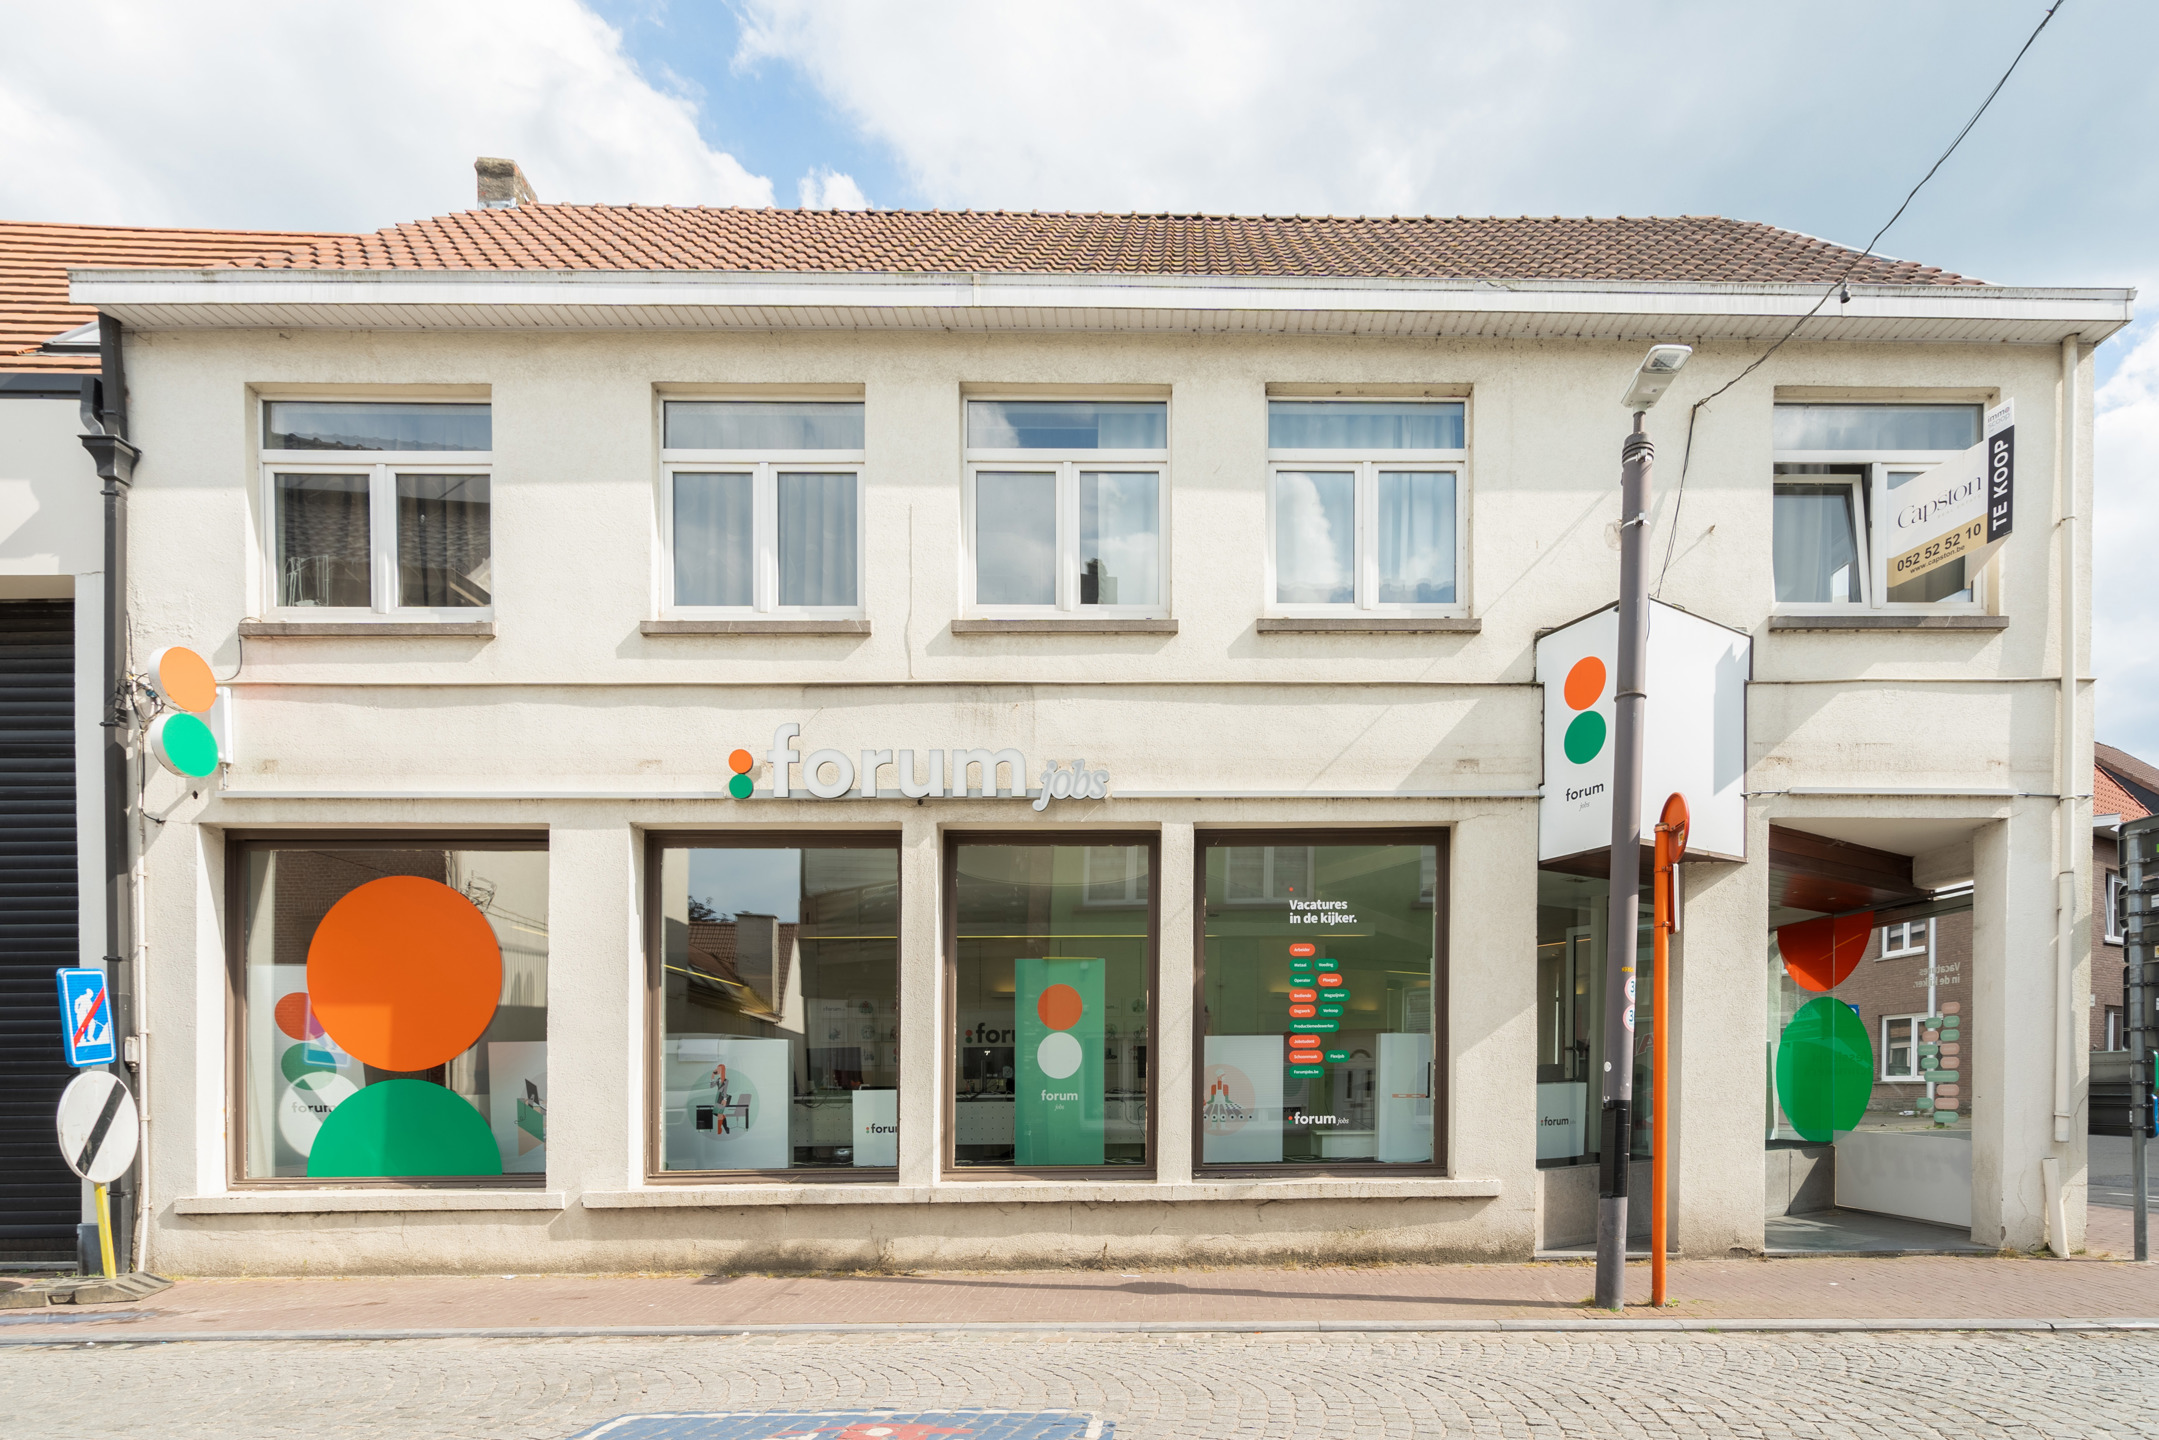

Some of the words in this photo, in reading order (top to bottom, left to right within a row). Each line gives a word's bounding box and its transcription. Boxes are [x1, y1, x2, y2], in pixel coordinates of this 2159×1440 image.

[1993, 440, 2009, 498] KOOP
[1897, 477, 1981, 529] Capston
[1993, 501, 2008, 531] TE
[1897, 552, 1920, 572] 052
[1924, 543, 1940, 559] 52
[1944, 533, 1960, 550] 52
[1965, 523, 1981, 539] 10
[1910, 545, 1966, 573] www.capston.be
[767, 723, 1027, 799] forum
[1032, 758, 1110, 812] jobs
[1566, 783, 1604, 802] forum
[1289, 899, 1348, 911] Vacatures
[1289, 912, 1301, 924] in
[1303, 912, 1318, 924] de
[1320, 912, 1358, 926] kijker.
[1041, 1089, 1079, 1101] forum
[1294, 1111, 1337, 1125] forum
[1336, 1117, 1350, 1126] jobs
[1544, 1116, 1569, 1126] forum
[870, 1123, 897, 1134] foru
